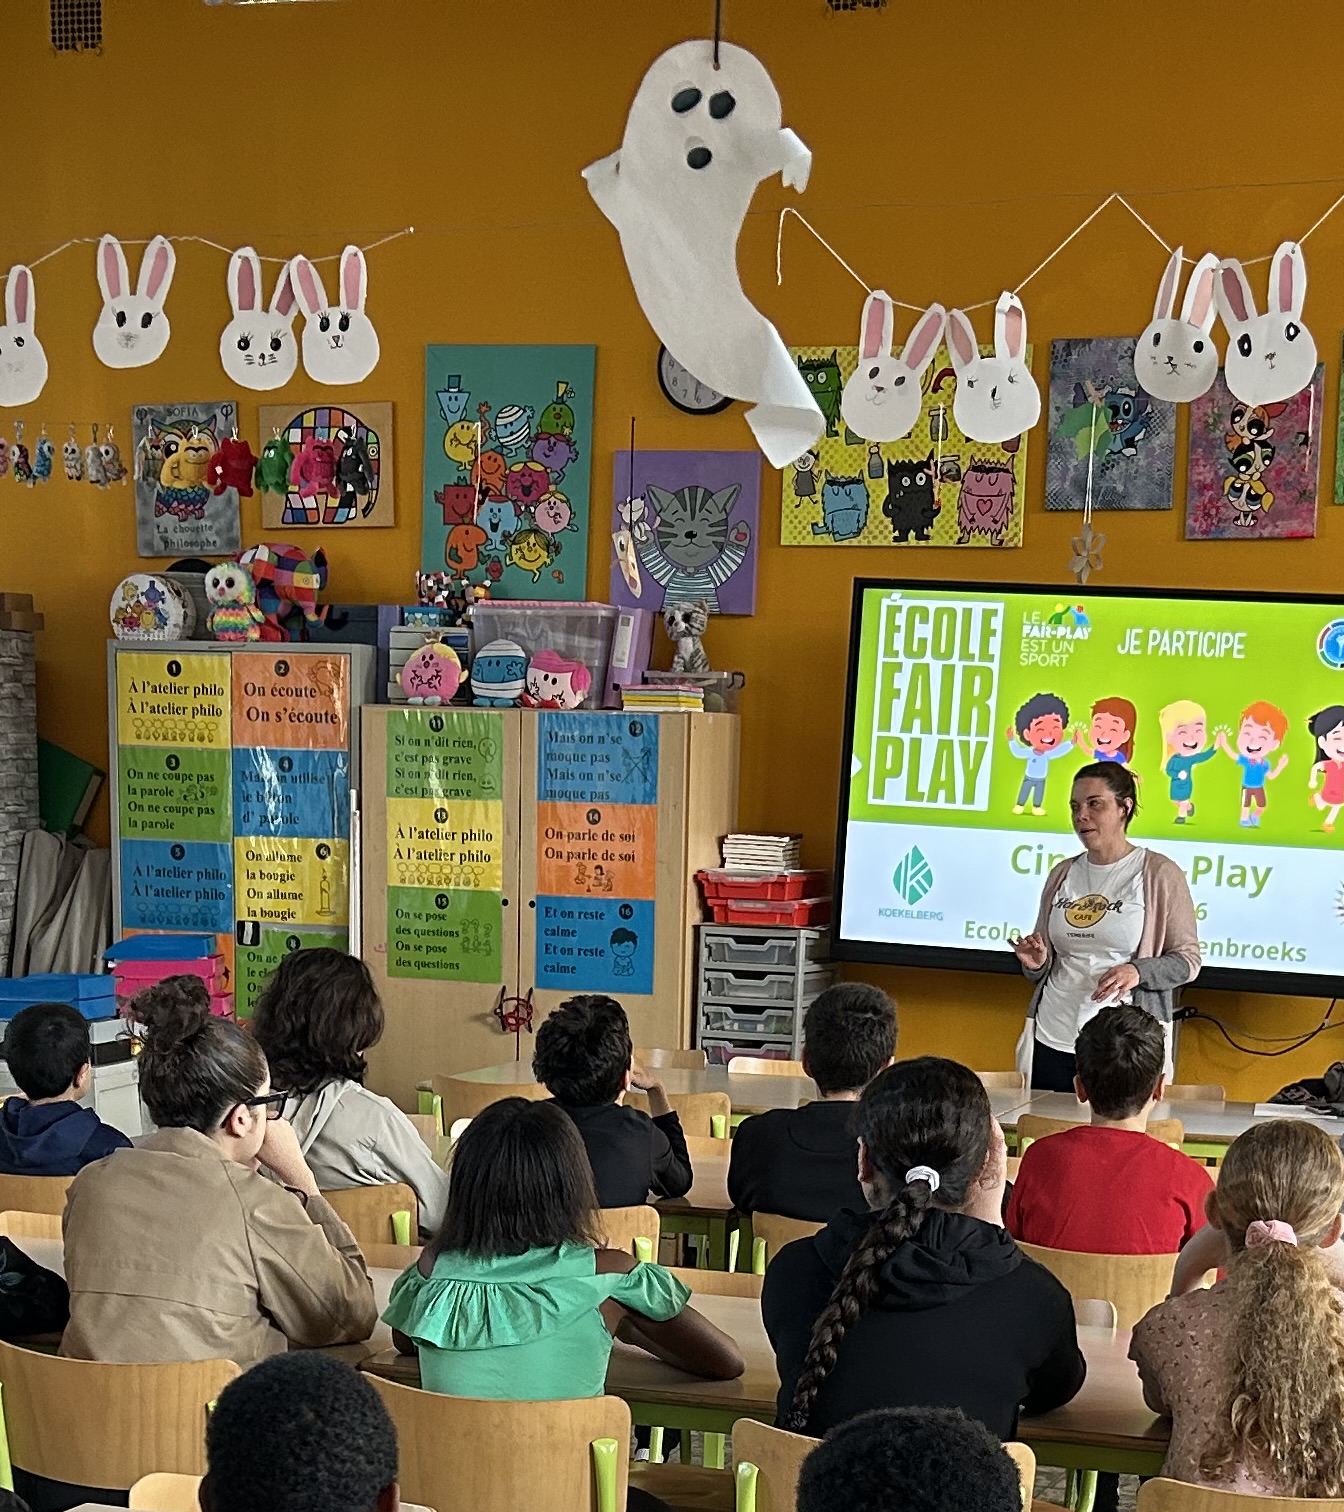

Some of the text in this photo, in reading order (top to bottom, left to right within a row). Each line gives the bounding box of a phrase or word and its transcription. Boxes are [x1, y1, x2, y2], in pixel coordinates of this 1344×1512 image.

[672, 377, 678, 386] 8
[682, 389, 688, 398] 7
[167, 407, 199, 417] SOFIA
[157, 523, 213, 534] La chouette
[163, 539, 218, 550] philosophe
[1023, 611, 1040, 625] LE
[883, 592, 998, 663] ÉCOLE
[1021, 640, 1074, 654] EST UN
[1117, 628, 1247, 659] JE PARTICIPE
[1019, 653, 1068, 667] SPORT
[171, 663, 177, 673] 1
[279, 665, 285, 674] 2
[128, 677, 225, 699] À l'atelier philo
[244, 682, 317, 698] On écoute
[877, 661, 993, 738] FAIR
[127, 697, 223, 719] À l'atelier philo
[246, 706, 338, 725] On s'écoute
[431, 719, 441, 728] 11
[395, 735, 477, 750] Si on n'dit rien,
[547, 731, 623, 745] Mais on n'se
[170, 759, 176, 767] 3
[395, 752, 472, 766] c'est pas grave
[546, 752, 611, 766] moque pas
[127, 769, 215, 785] On ne coupe pas
[395, 767, 477, 783] Si on rien,
[546, 767, 622, 782] Mais on n'se
[872, 735, 988, 805] PLAY
[291, 771, 326, 784] utilise
[127, 785, 174, 799] la parole
[242, 790, 253, 802] le
[395, 784, 472, 798] c'est grave
[545, 788, 610, 803] moque pas
[128, 801, 215, 817] On ne coupe pas
[436, 811, 446, 820] 13
[242, 811, 254, 824] d'
[588, 812, 599, 821] 14
[128, 817, 175, 831] la parole
[395, 823, 493, 844] À l'atelier philo
[545, 827, 636, 843] On parle de soi
[175, 848, 181, 856] 5
[246, 850, 303, 863] On allume
[320, 847, 327, 856] 6
[393, 844, 491, 865] À l'atelier philo
[545, 847, 636, 863] On parle de soi
[133, 860, 227, 884] À l'atelier philo
[246, 869, 295, 884] la bougie
[132, 880, 225, 902] À l'atelier philo
[247, 888, 304, 900] On allume
[437, 897, 447, 906] 15
[247, 907, 296, 921] la bougie
[395, 909, 447, 922] On se pose
[544, 906, 606, 920] Et on reste
[620, 907, 632, 916] 16
[878, 907, 944, 921] KOEKELBERG
[395, 926, 460, 938] des questions
[544, 926, 577, 938] calme
[964, 920, 1021, 941] Ecole
[395, 941, 447, 955] On se pose
[544, 943, 606, 957] Et on reste
[247, 951, 262, 962] On
[266, 954, 278, 963] ne
[395, 957, 460, 970] des questions
[247, 967, 256, 977] le
[544, 963, 577, 975] calme
